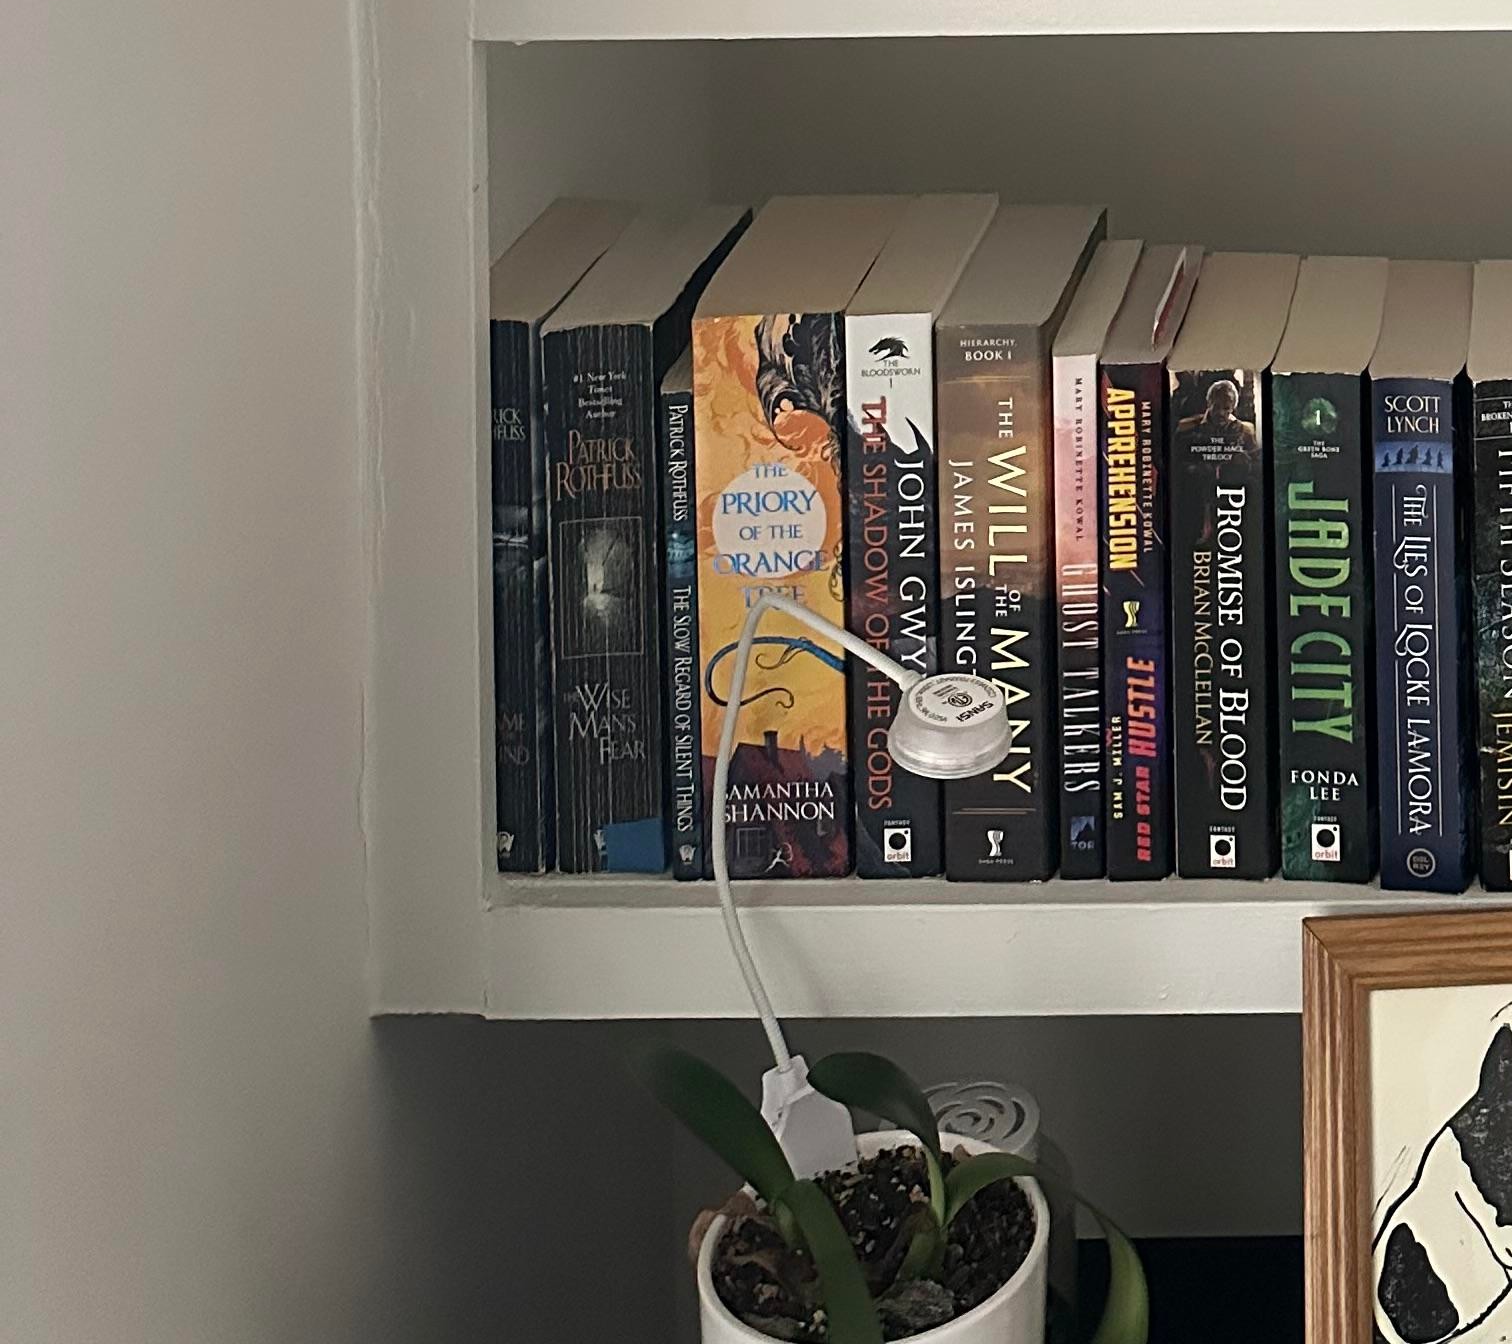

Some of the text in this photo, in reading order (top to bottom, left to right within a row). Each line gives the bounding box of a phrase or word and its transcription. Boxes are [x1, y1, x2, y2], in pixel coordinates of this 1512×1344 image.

[965, 350, 1002, 361] BOOK
[1384, 396, 1440, 413] SCOTT
[1387, 417, 1439, 433] LYNCH
[1106, 387, 1135, 573] APPREHENSION
[721, 488, 818, 515] PRIORY
[897, 459, 927, 560] JOHN
[987, 446, 1027, 577] WILL
[713, 550, 829, 576] ORANGE
[1287, 482, 1353, 744] JADE CITY
[1216, 486, 1247, 811] PROMISE OF BLOOD
[956, 700, 994, 722] SANSI
[1127, 657, 1158, 758] HUSTLE
[1290, 769, 1359, 786] FONDA
[1309, 786, 1341, 801] LEE
